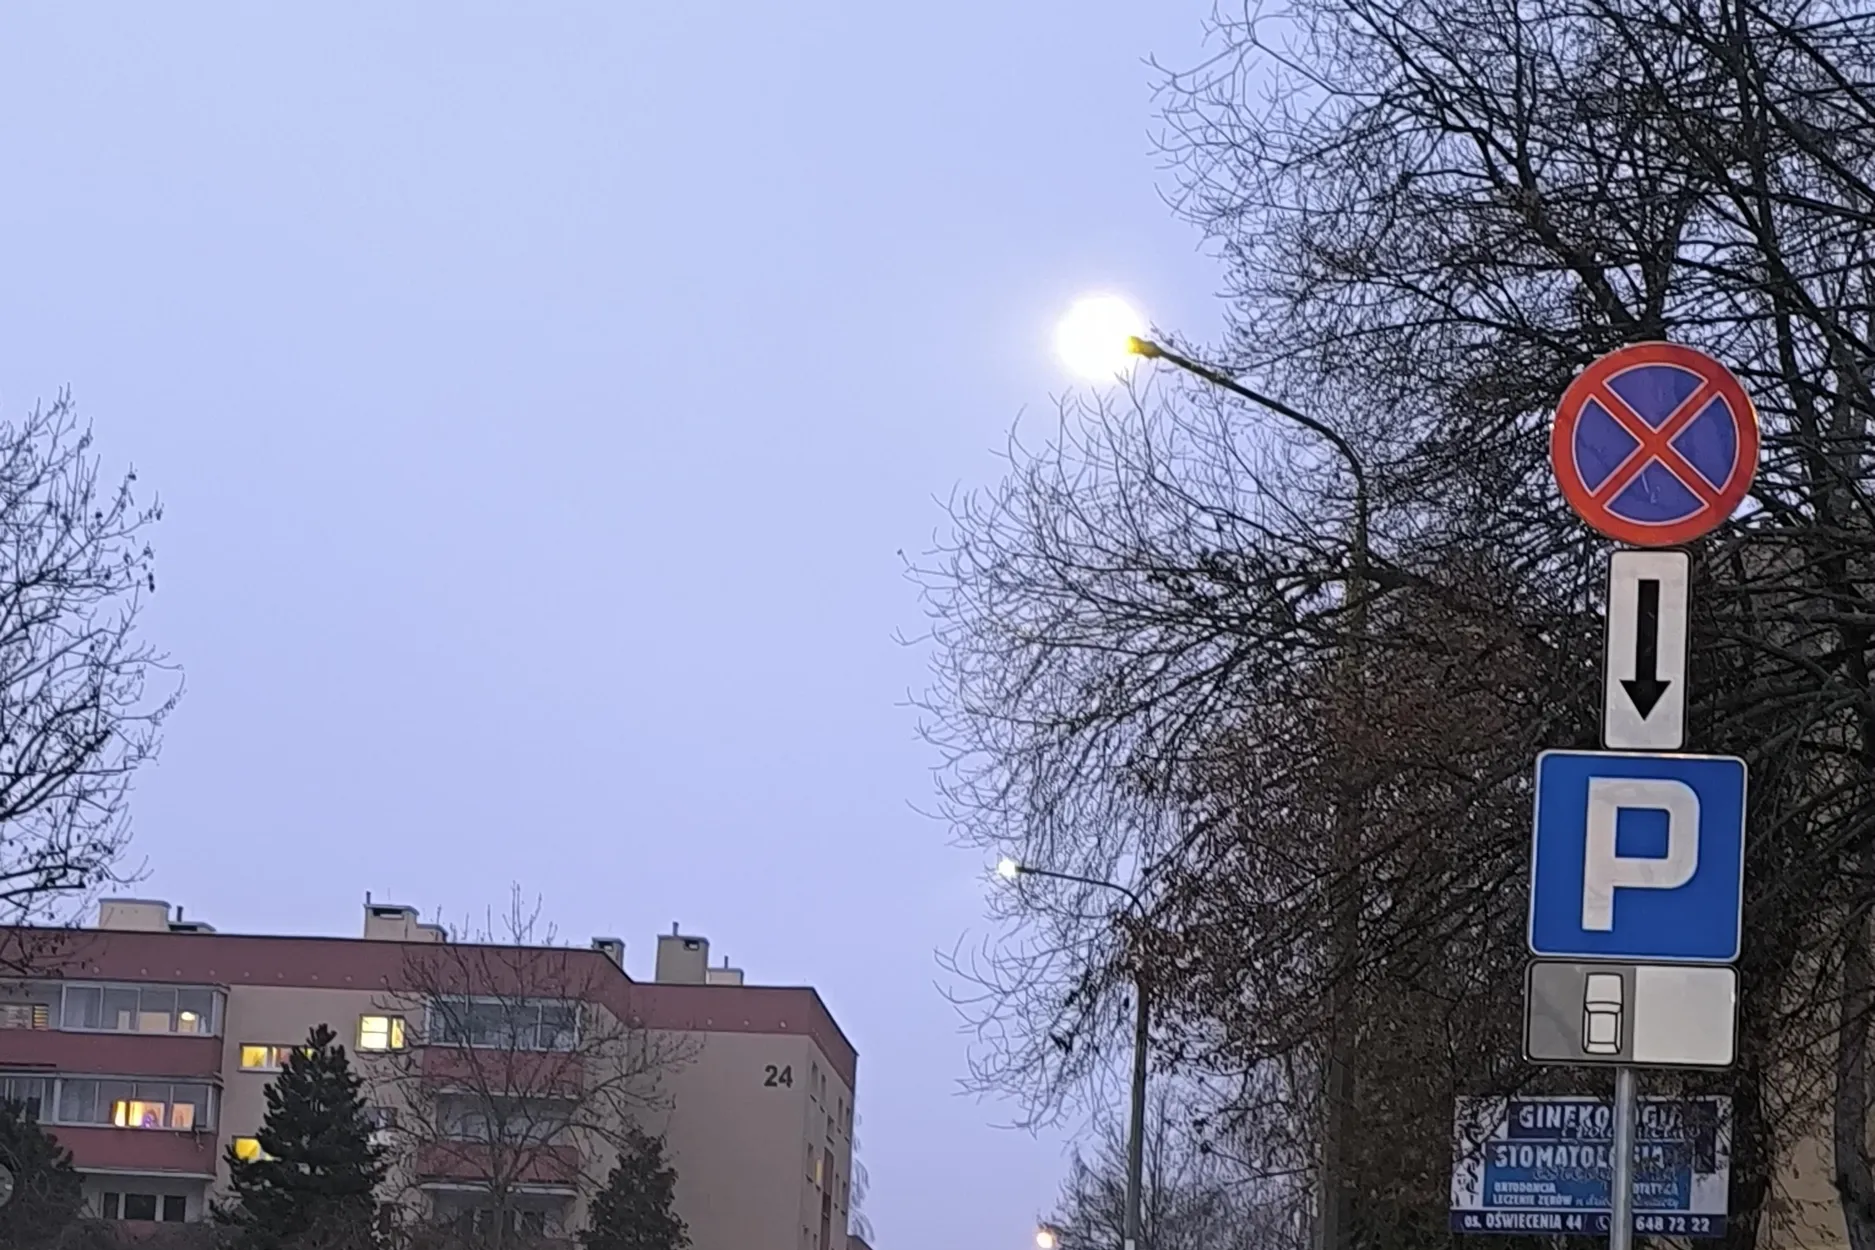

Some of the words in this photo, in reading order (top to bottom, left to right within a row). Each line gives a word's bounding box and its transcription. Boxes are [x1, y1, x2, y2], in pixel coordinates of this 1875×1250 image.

[1582, 776, 1700, 932] P
[764, 1064, 793, 1088] 24
[1486, 1209, 1562, 1230] OŚWIECENIA
[1566, 1214, 1582, 1231] 44
[1635, 1215, 1664, 1232] 648
[1668, 1216, 1686, 1233] 72
[1691, 1217, 1711, 1233] 22
